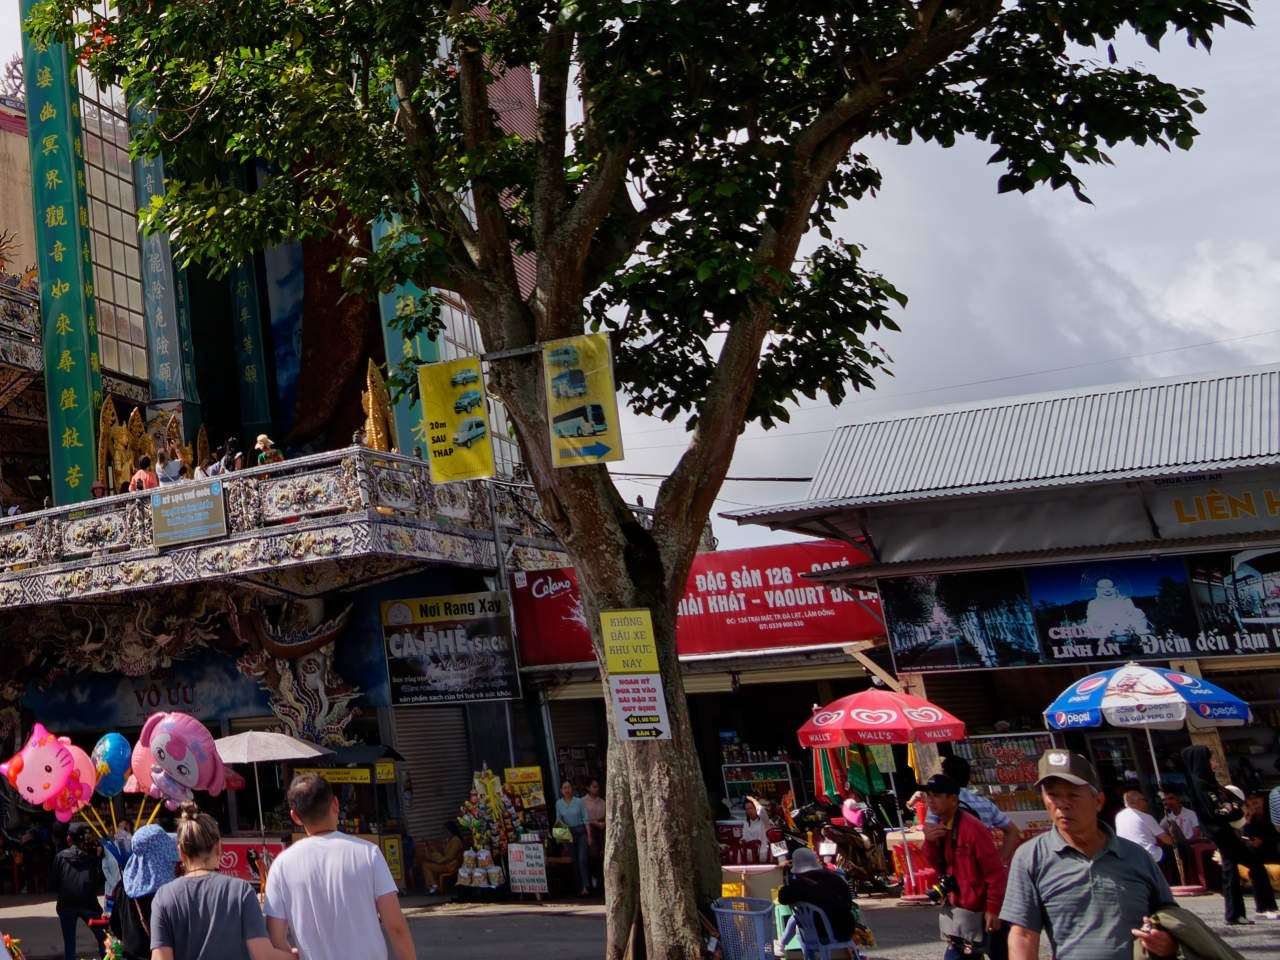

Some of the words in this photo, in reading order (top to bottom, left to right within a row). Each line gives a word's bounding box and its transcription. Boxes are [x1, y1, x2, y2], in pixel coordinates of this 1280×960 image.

[429, 421, 447, 430] 20m
[431, 434, 447, 444] SAU
[1173, 487, 1257, 524] LIÊN
[695, 570, 727, 595] ĐẶC
[765, 566, 792, 586] 126
[764, 586, 825, 609] YAOURT
[420, 602, 440, 618] Nơi
[444, 601, 475, 615] Rang
[479, 598, 501, 613] Xay
[633, 630, 647, 640] XE
[1139, 628, 1192, 654] Điểm
[1196, 628, 1230, 652] đến
[609, 645, 629, 655] KHU
[1051, 644, 1094, 658] LINH
[134, 683, 161, 707] VÔ
[1066, 711, 1091, 724] pepsi
[1212, 706, 1237, 718] pepsi
[808, 732, 832, 742] WALL'S
[857, 731, 893, 740] WALL'S
[925, 728, 953, 739] WALL'S
